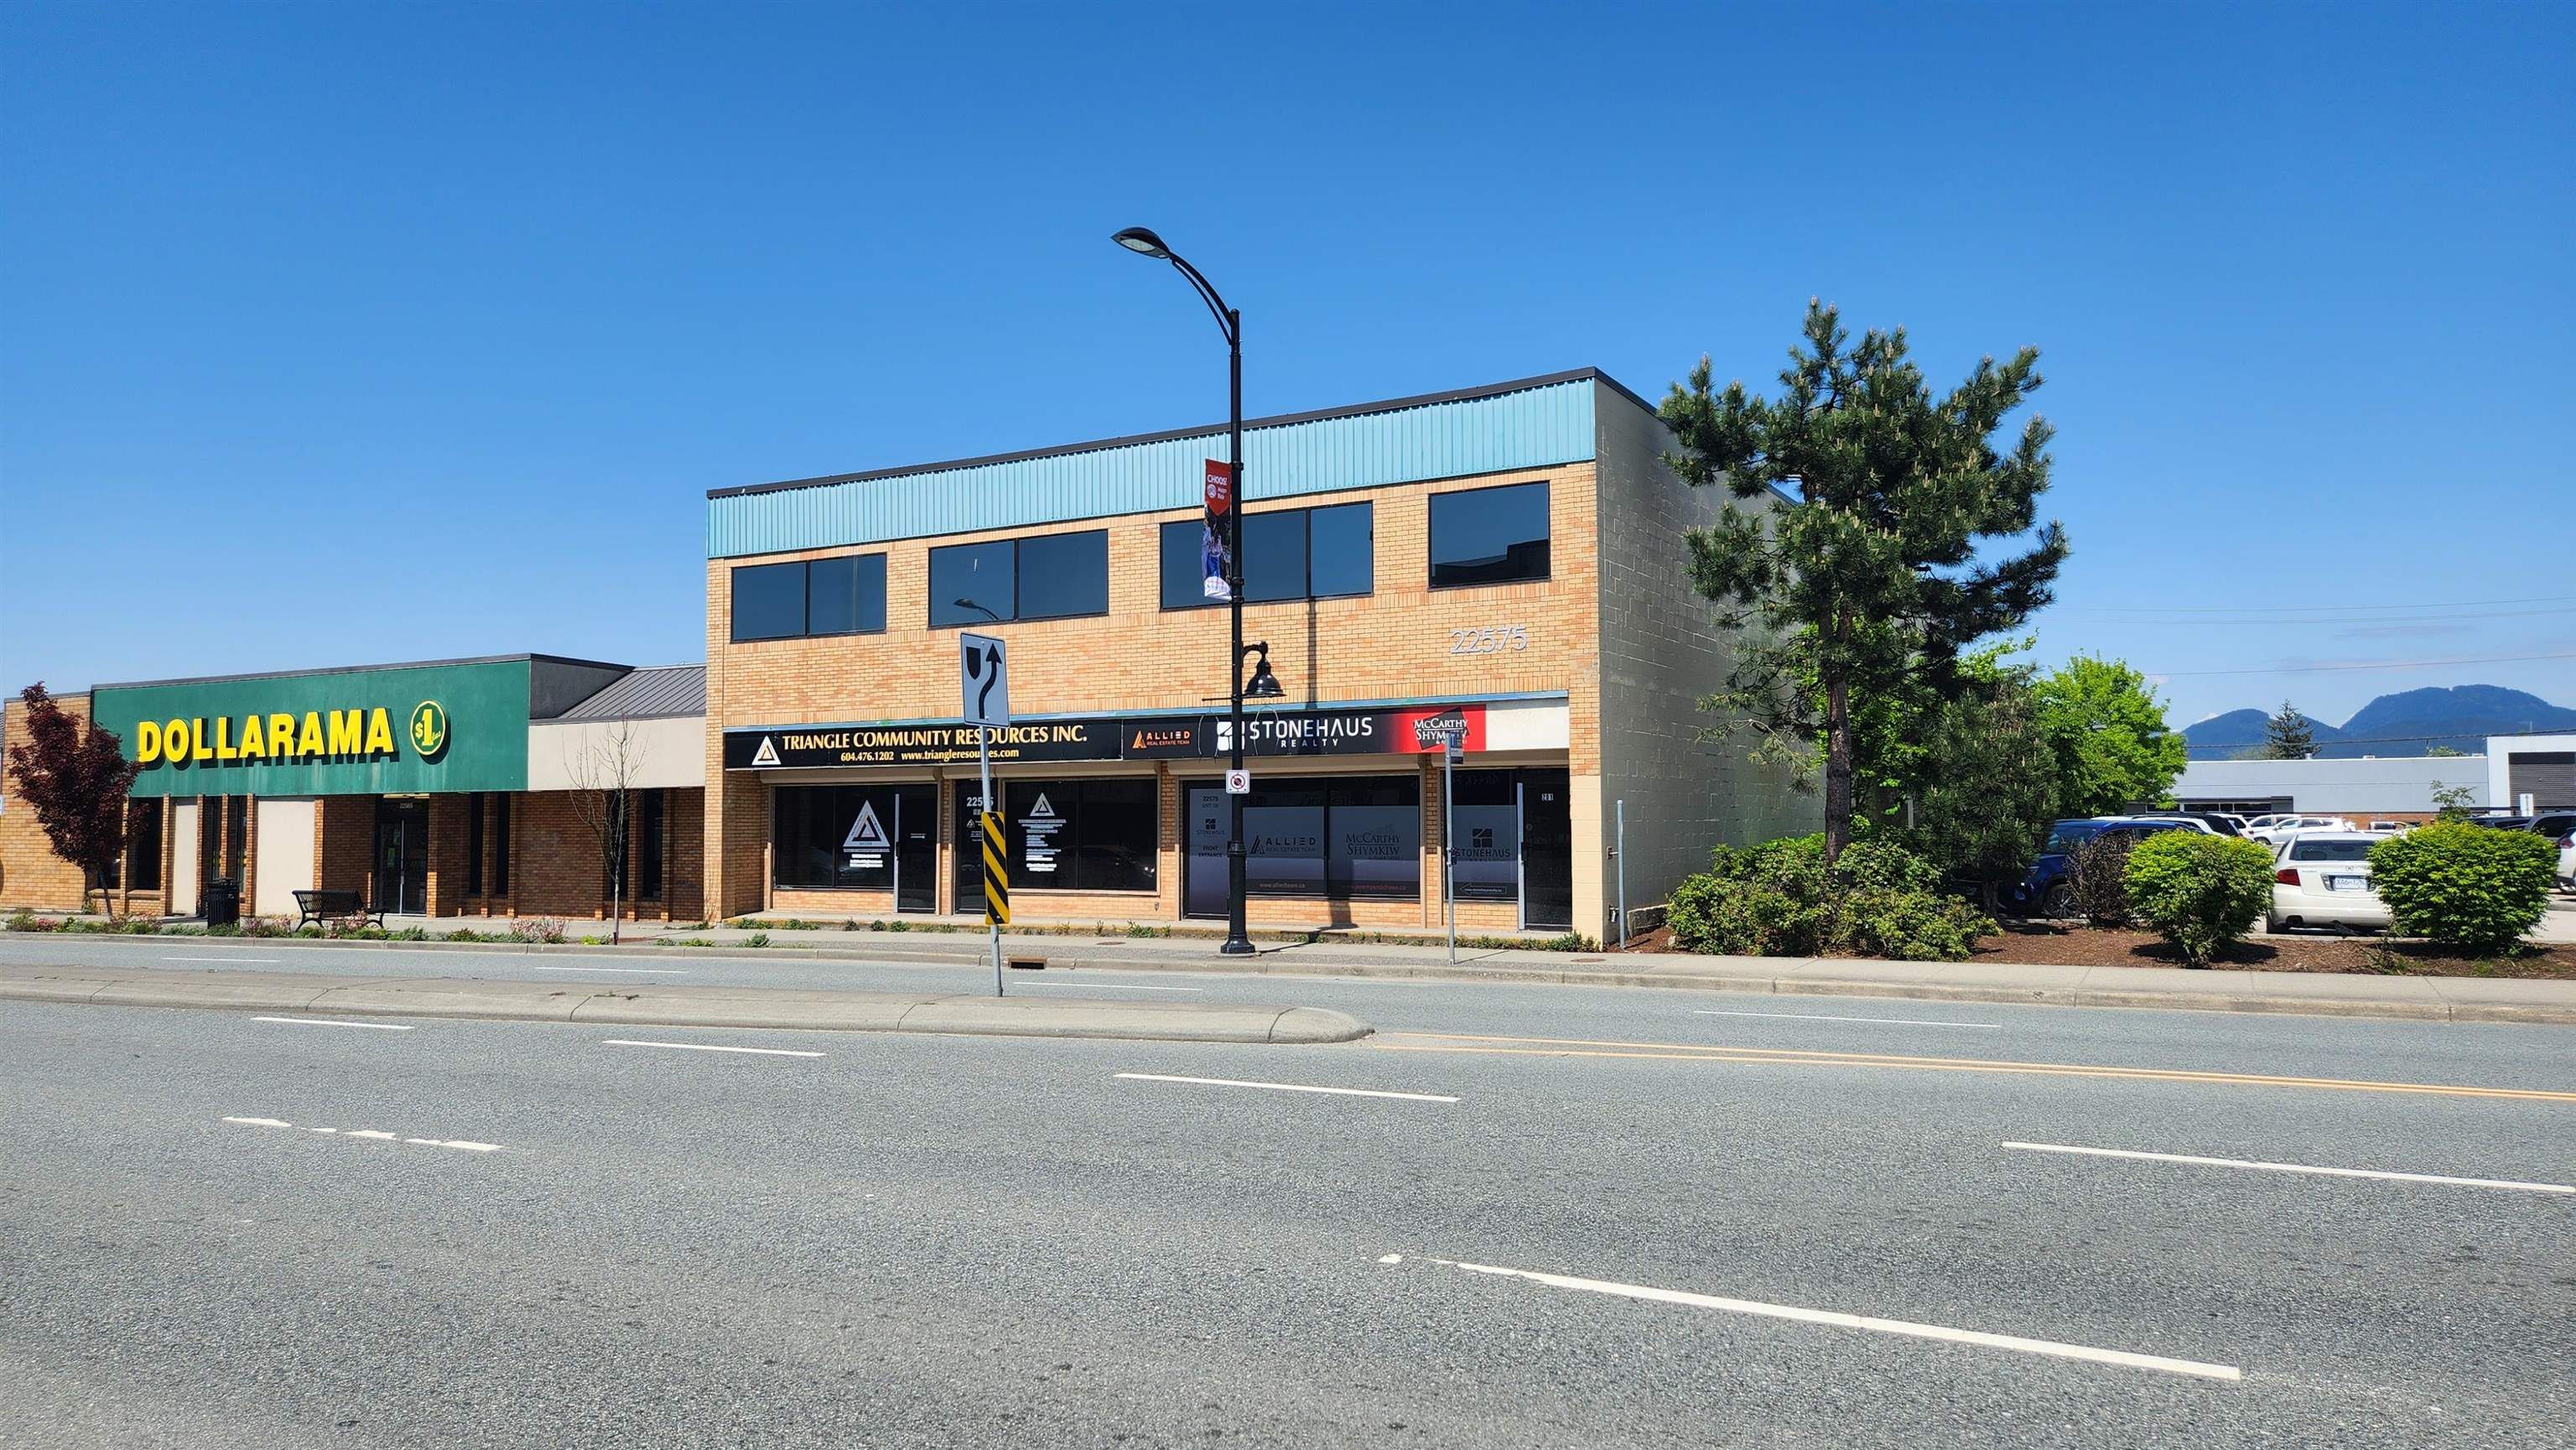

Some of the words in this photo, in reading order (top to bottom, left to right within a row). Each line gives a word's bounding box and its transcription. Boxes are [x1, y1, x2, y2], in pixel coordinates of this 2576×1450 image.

[1450, 626, 1527, 654] 22575
[1249, 716, 1373, 740] STONEHAUS
[1415, 728, 1467, 741] SHYM
[138, 708, 394, 762] DOLLARAMA
[782, 733, 850, 750] TRIANGLE
[854, 730, 951, 747] COMMUNITY
[1053, 725, 1088, 742] INC.
[1146, 730, 1191, 741] ALLIED
[1281, 738, 1338, 748] REALTY
[840, 751, 895, 761] 604.476.1202
[901, 749, 1020, 762] www.triangleresoues.com
[966, 797, 995, 807] 2255
[1266, 837, 1316, 845] ALLIED
[1347, 843, 1400, 855] SHYMKIW
